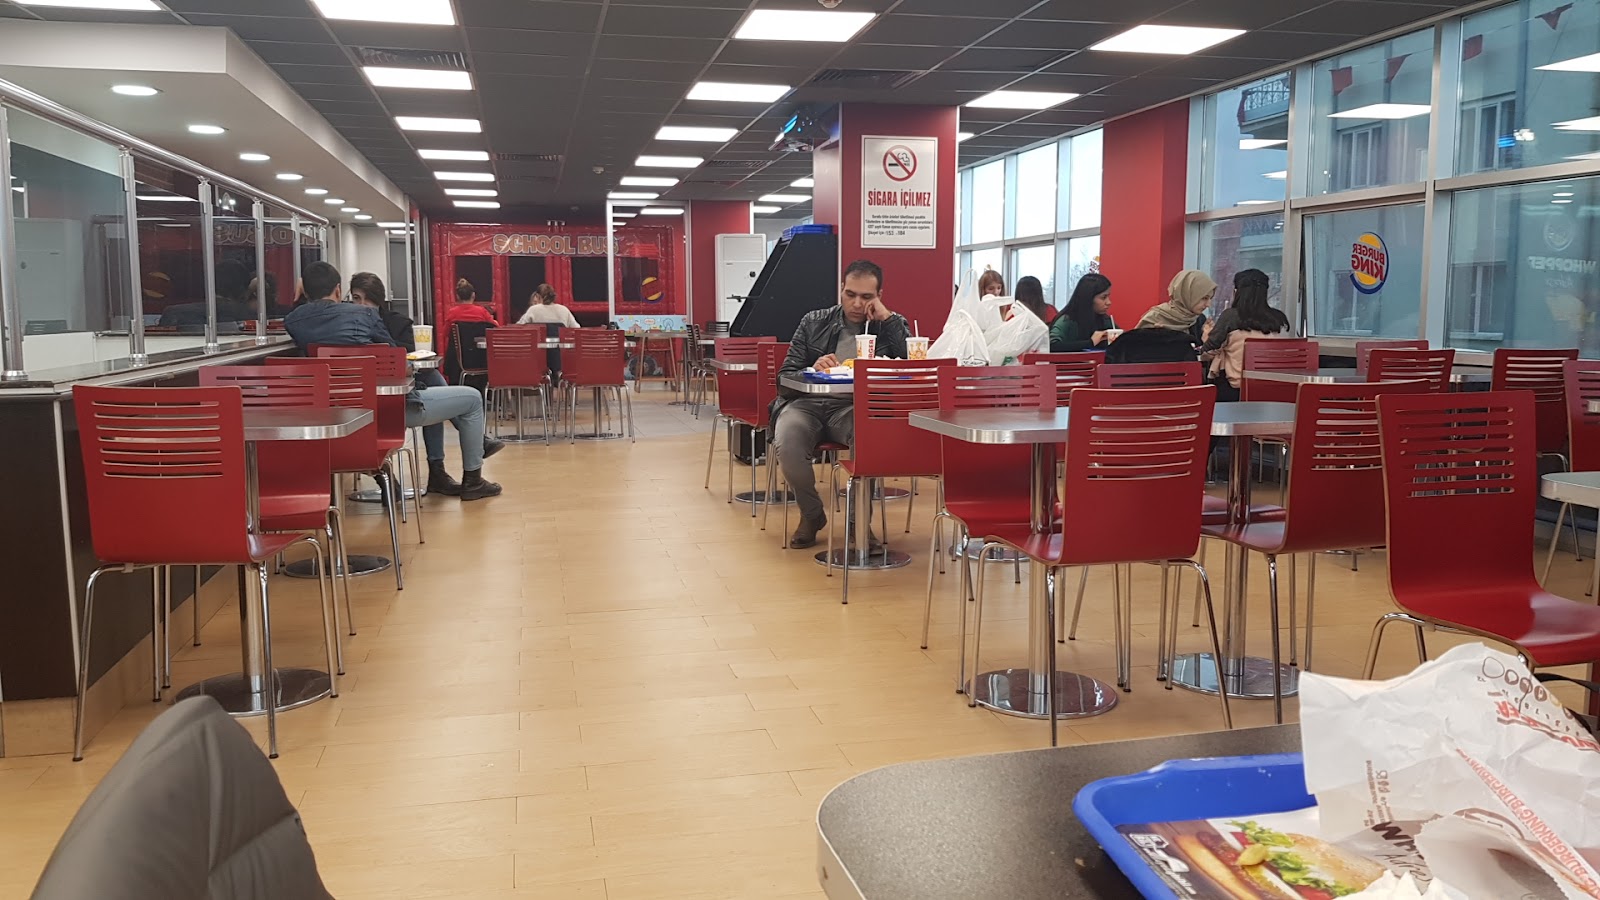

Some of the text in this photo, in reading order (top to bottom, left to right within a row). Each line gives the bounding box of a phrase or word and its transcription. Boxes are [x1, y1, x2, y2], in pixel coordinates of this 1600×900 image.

[868, 188, 931, 209] SİGARA İÇİLMEZ
[493, 233, 575, 254] SCHOOL
